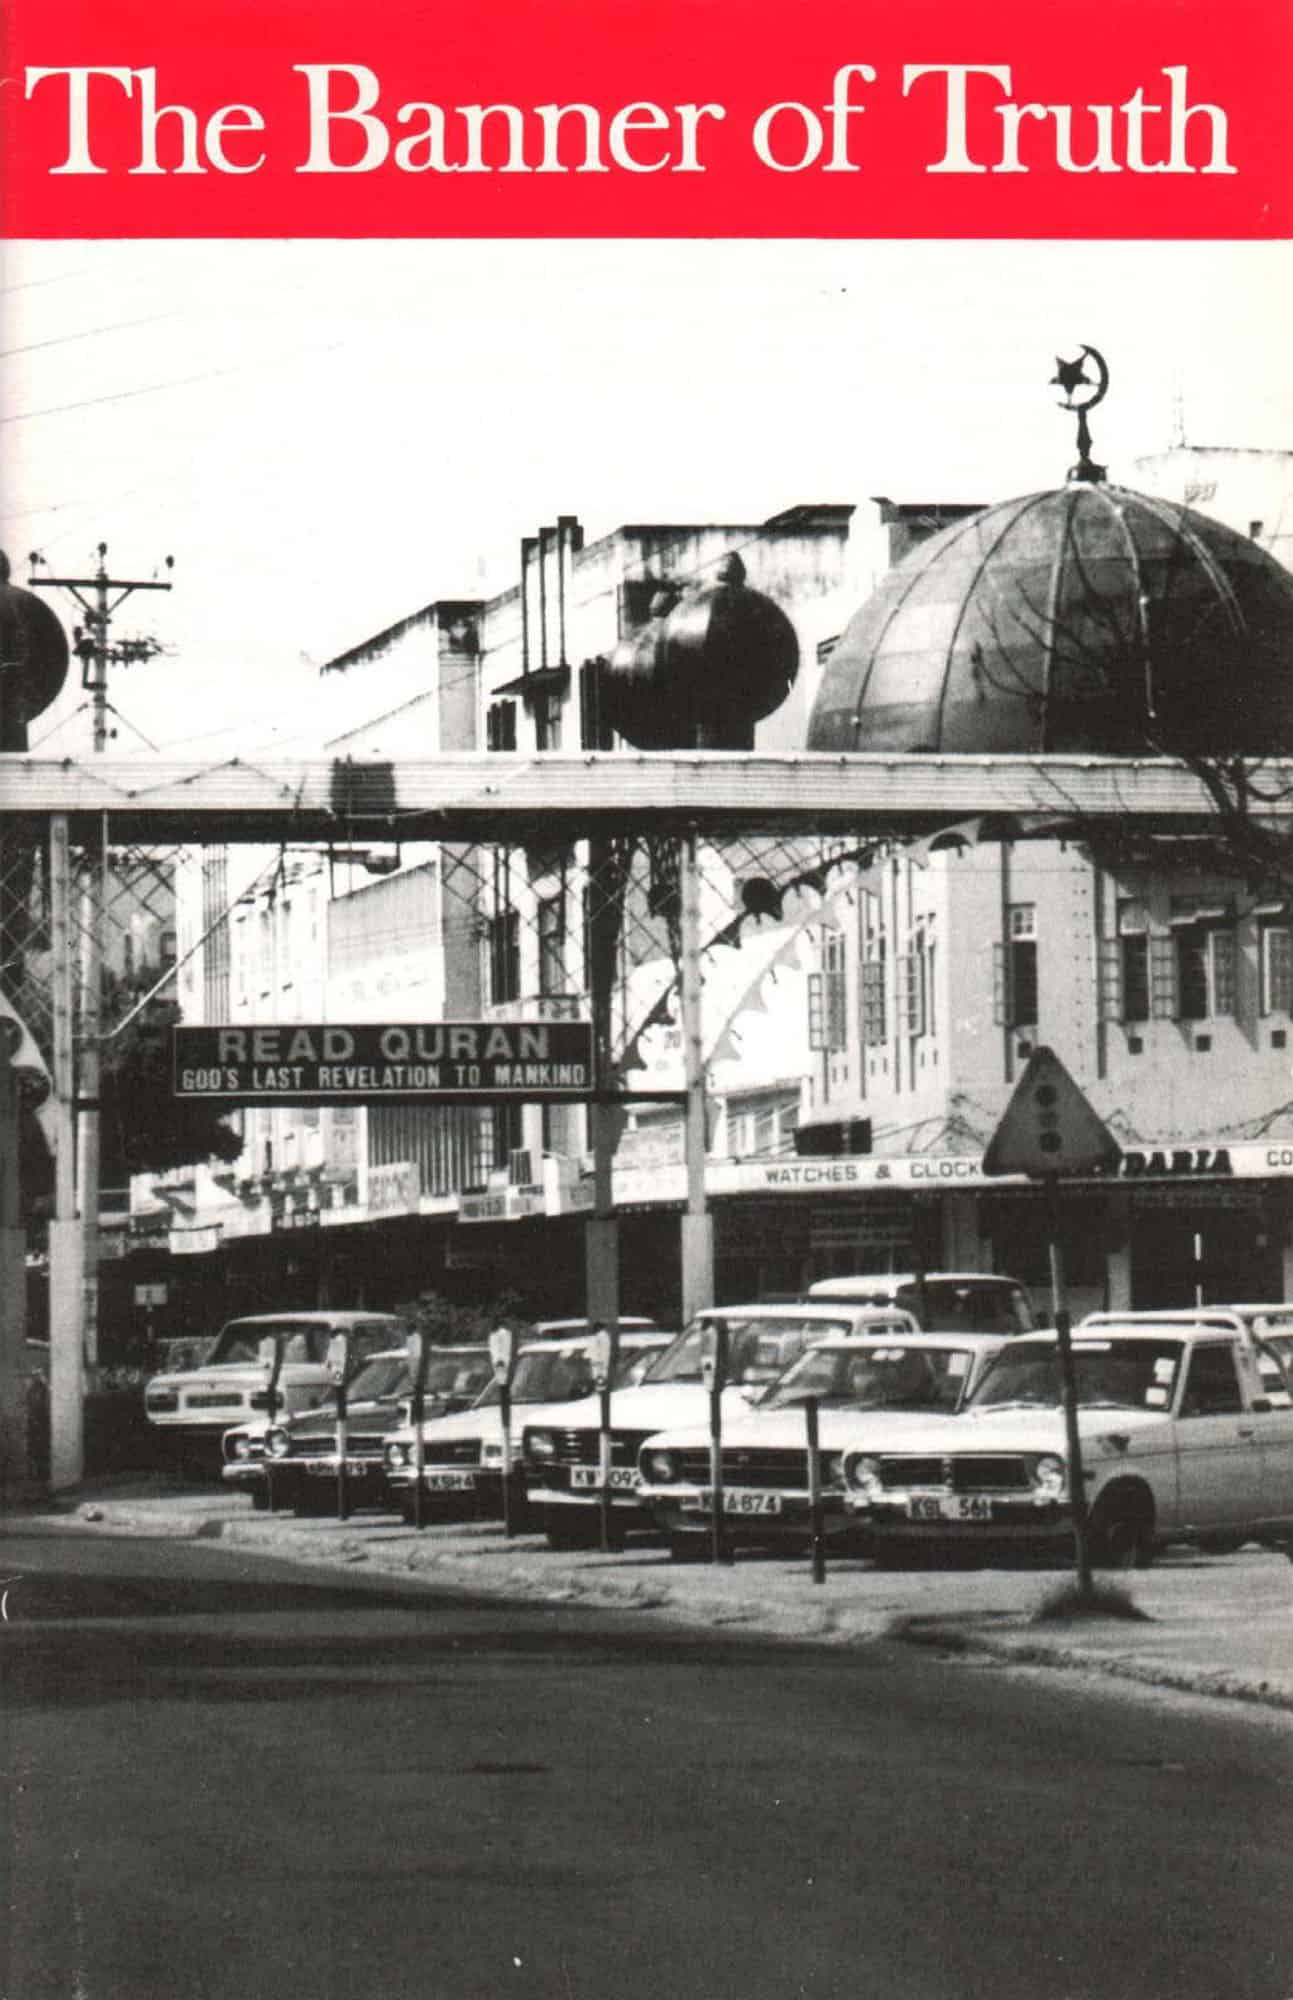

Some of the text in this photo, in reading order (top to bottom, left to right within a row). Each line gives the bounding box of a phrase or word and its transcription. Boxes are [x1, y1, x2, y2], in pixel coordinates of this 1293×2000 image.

[218, 1026, 549, 1063] READ QURAN
[182, 1063, 585, 1091] GOD'S LAST REVELATION TO MANKIND
[765, 1164, 858, 1184] WATCHES
[875, 1163, 892, 1179] &
